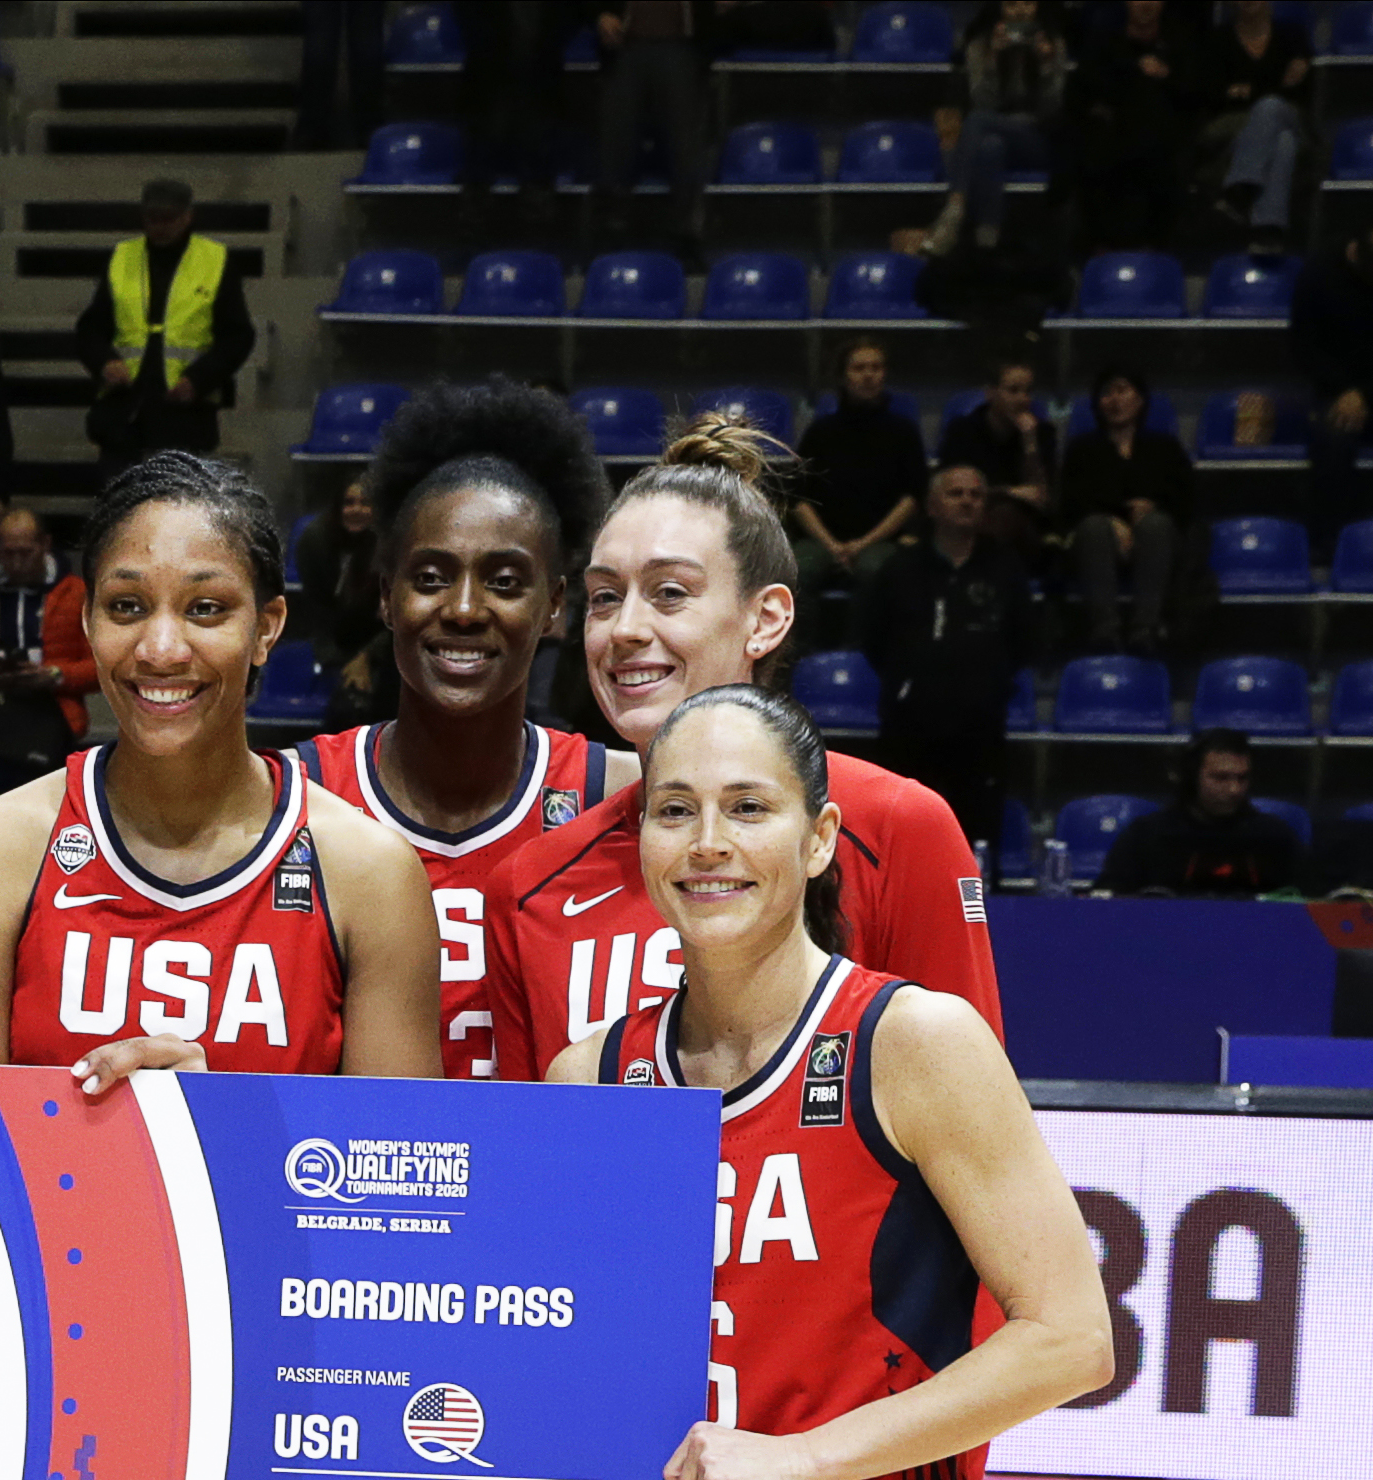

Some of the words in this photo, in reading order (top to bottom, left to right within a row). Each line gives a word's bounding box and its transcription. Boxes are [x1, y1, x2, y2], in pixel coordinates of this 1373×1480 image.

[64, 833, 89, 846] USA
[281, 873, 311, 890] FIBA
[59, 931, 289, 1047] USA
[568, 927, 686, 1044] US
[808, 1085, 838, 1103] FIBA
[349, 1140, 410, 1155] WOMEN'S
[414, 1142, 469, 1157] OLYMPIC
[346, 1180, 434, 1197] TOURNAMENTS
[435, 1184, 467, 1197] 2020
[297, 1215, 386, 1233] BELGRADE,
[390, 1218, 451, 1233] SERBIA
[281, 1278, 464, 1323] BOARDING
[475, 1285, 573, 1327] PASS
[277, 1367, 362, 1384] PASSENGER
[366, 1371, 410, 1386] NAME
[275, 1414, 358, 1460] USA
